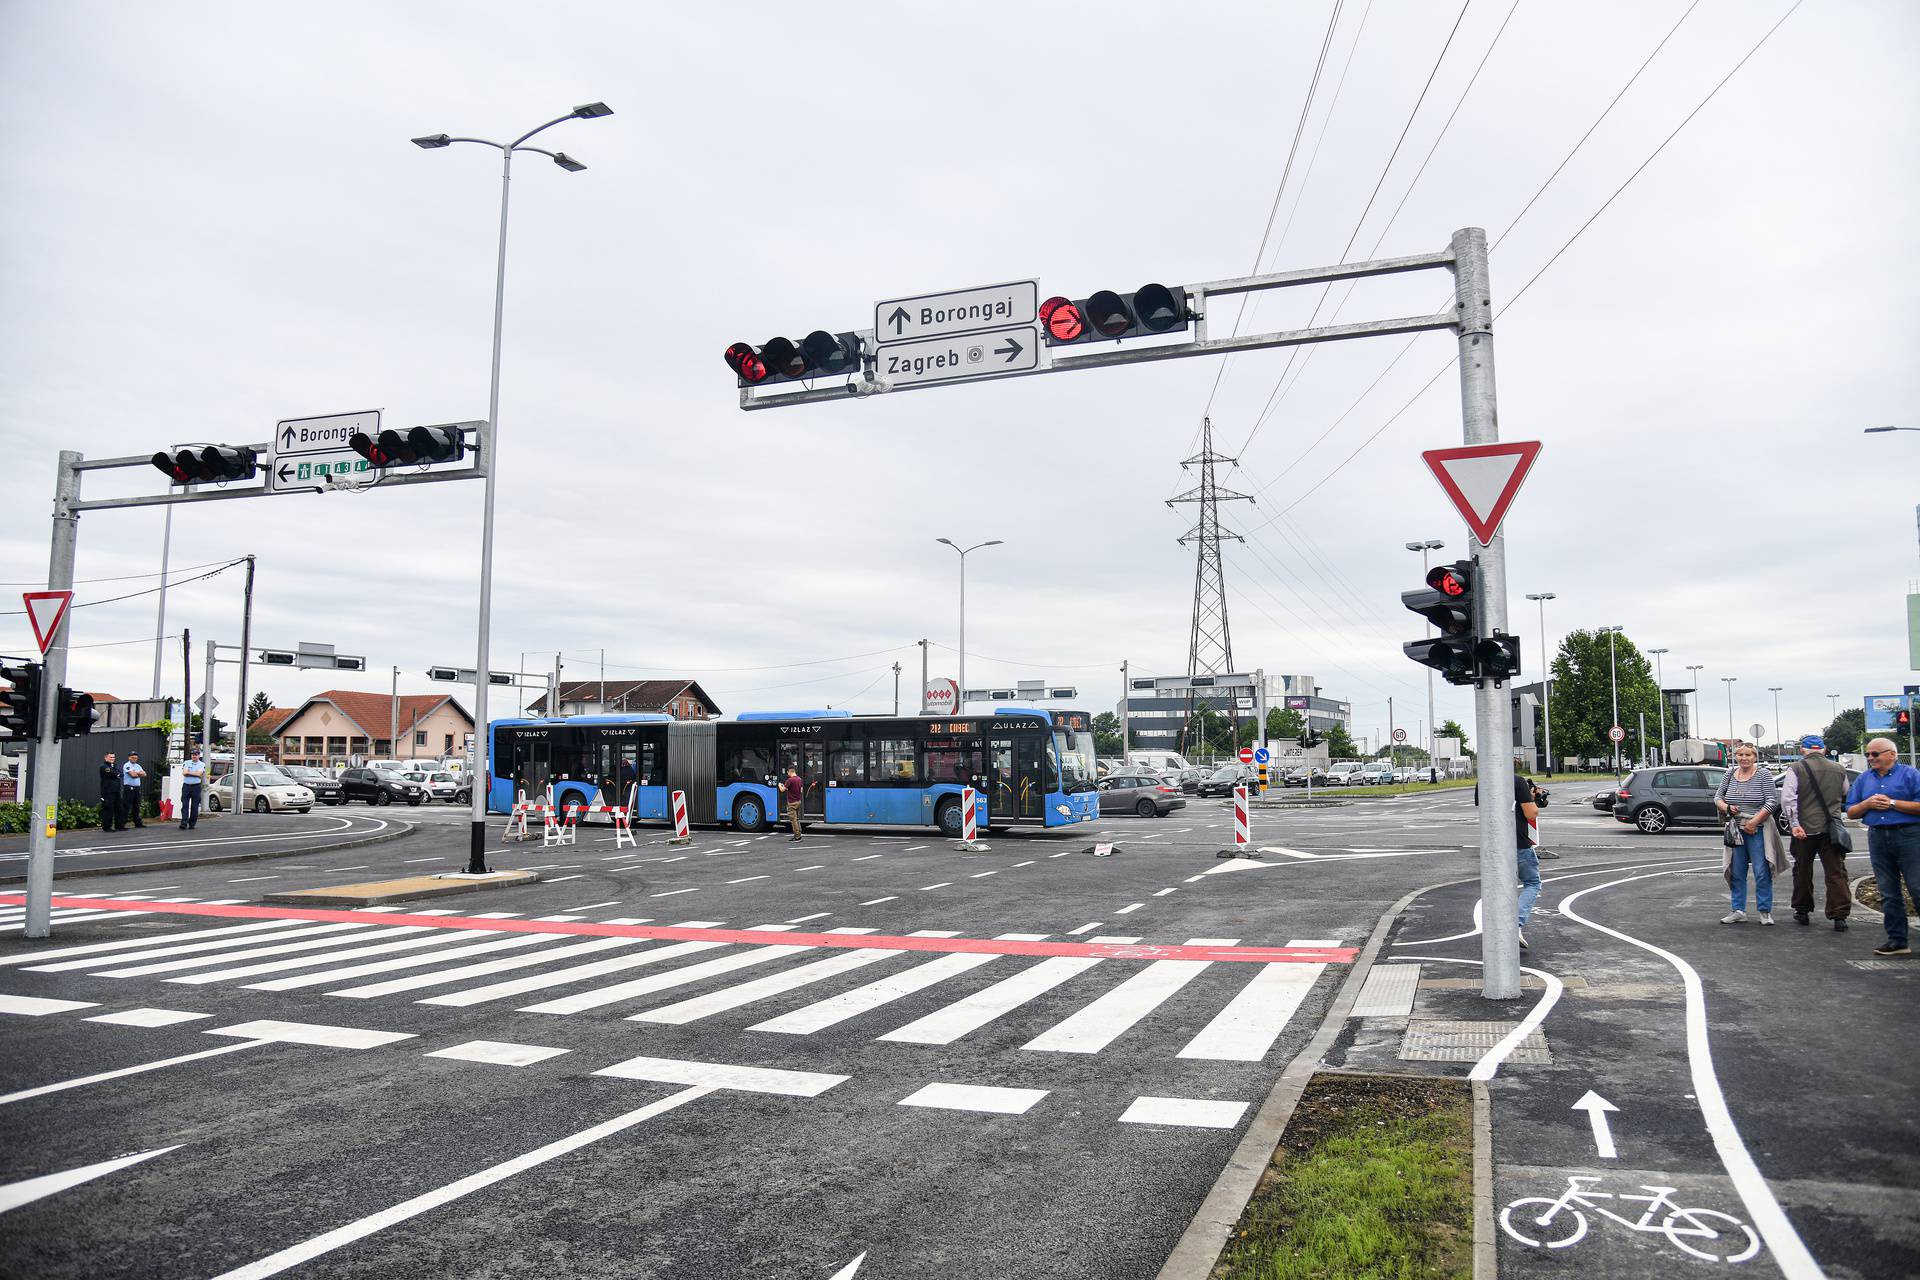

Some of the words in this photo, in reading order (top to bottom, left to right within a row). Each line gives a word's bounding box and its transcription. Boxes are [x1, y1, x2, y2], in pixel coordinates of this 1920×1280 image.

[920, 297, 1012, 325] Borongaj
[888, 349, 959, 375] Zagreb
[1612, 730, 1621, 738] 60
